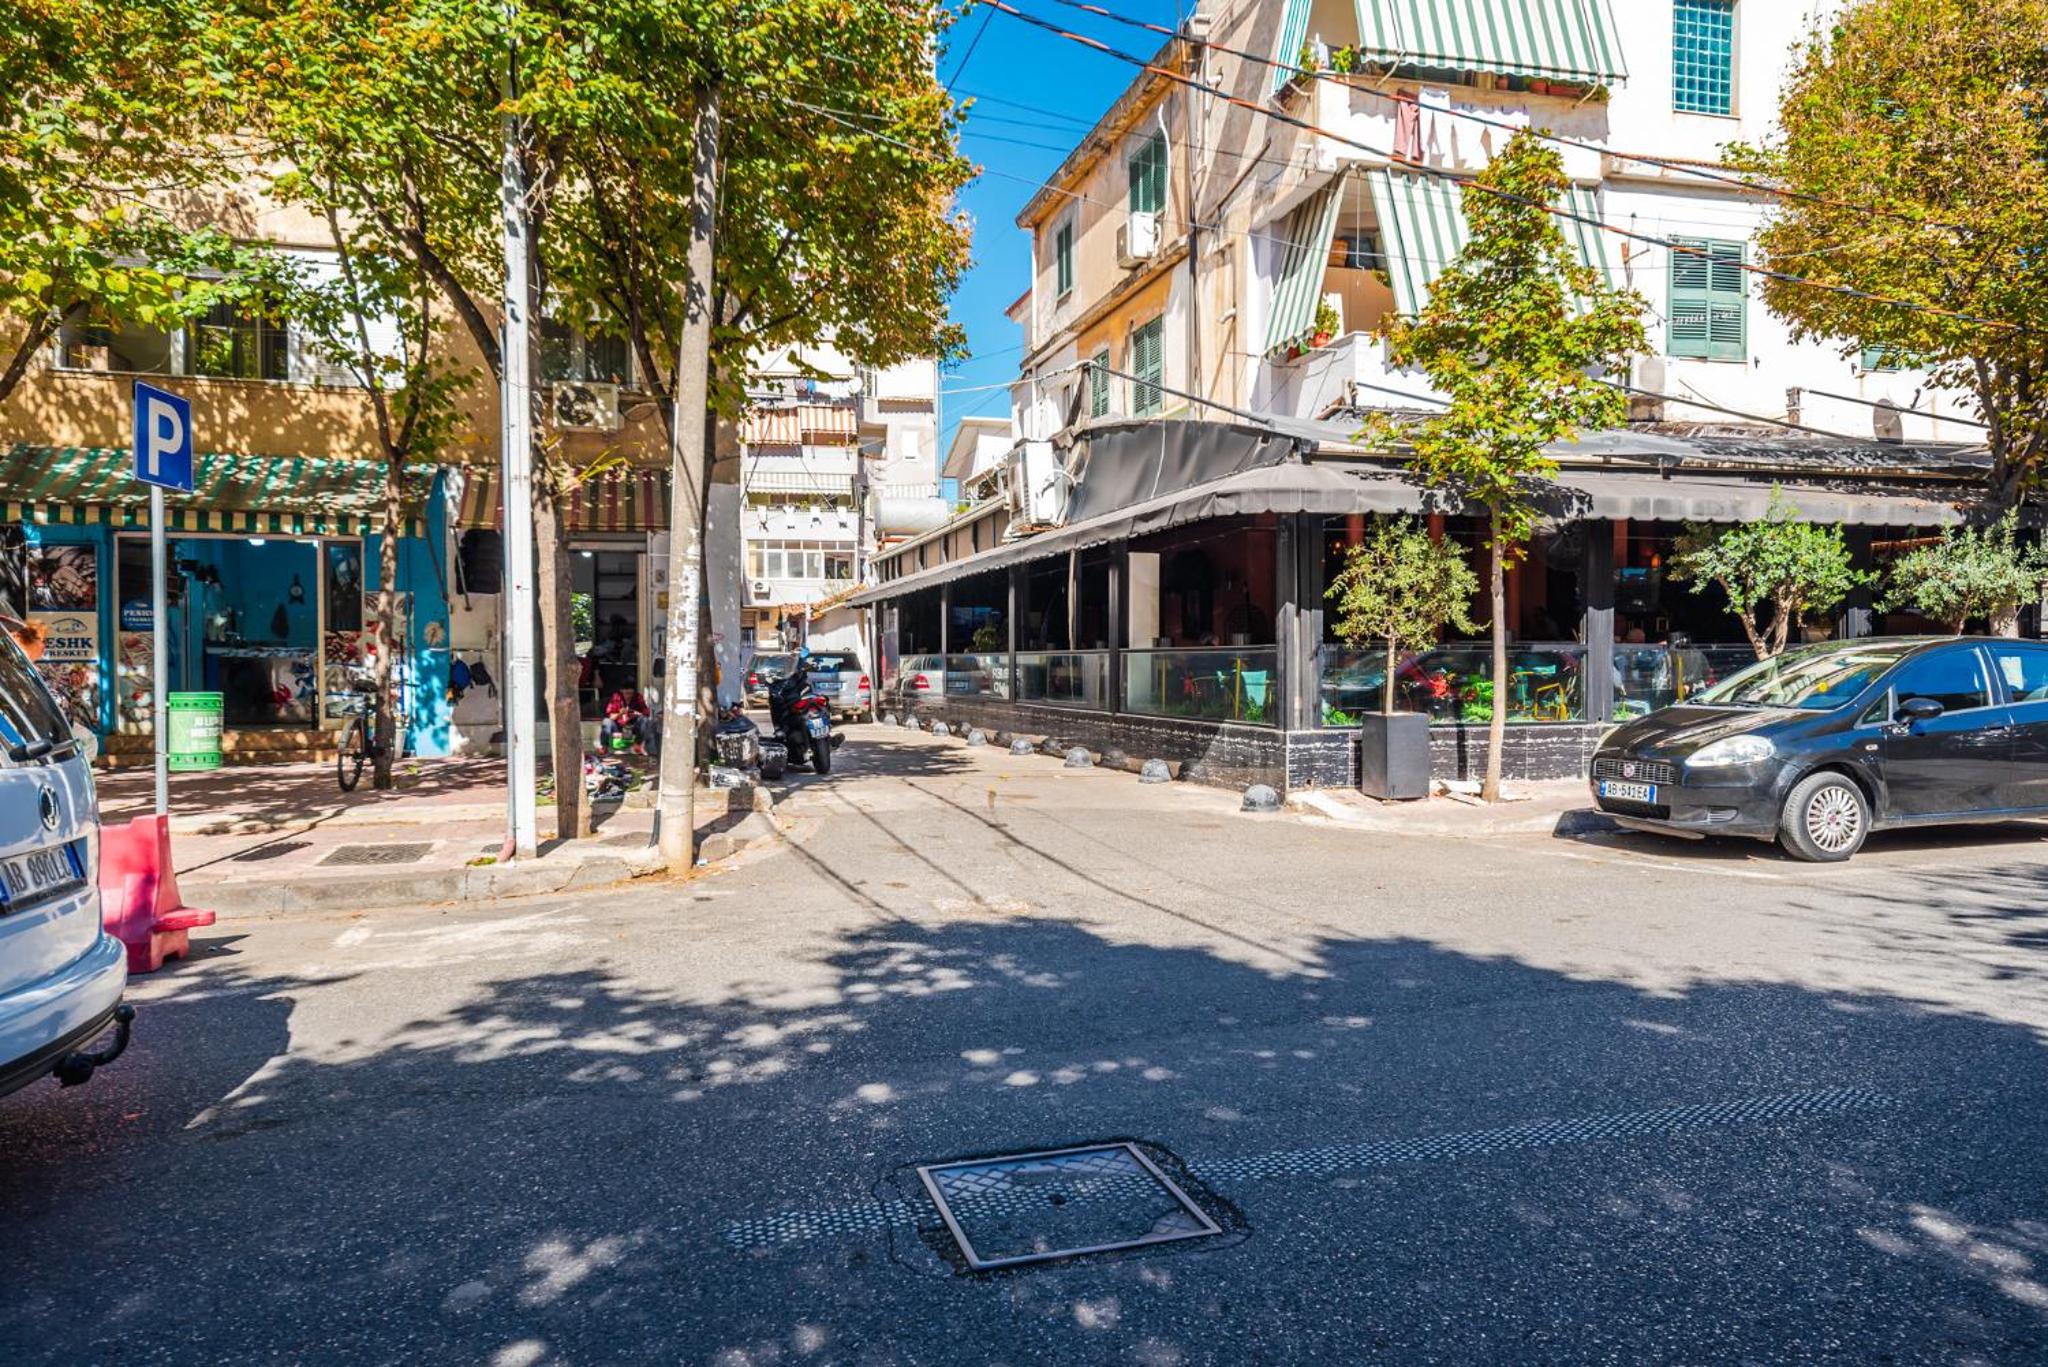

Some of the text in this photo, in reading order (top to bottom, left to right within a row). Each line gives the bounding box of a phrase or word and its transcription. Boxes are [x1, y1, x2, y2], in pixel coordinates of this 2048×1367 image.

[148, 396, 184, 476] P
[45, 637, 94, 649] ESHK
[4, 861, 28, 895] AB
